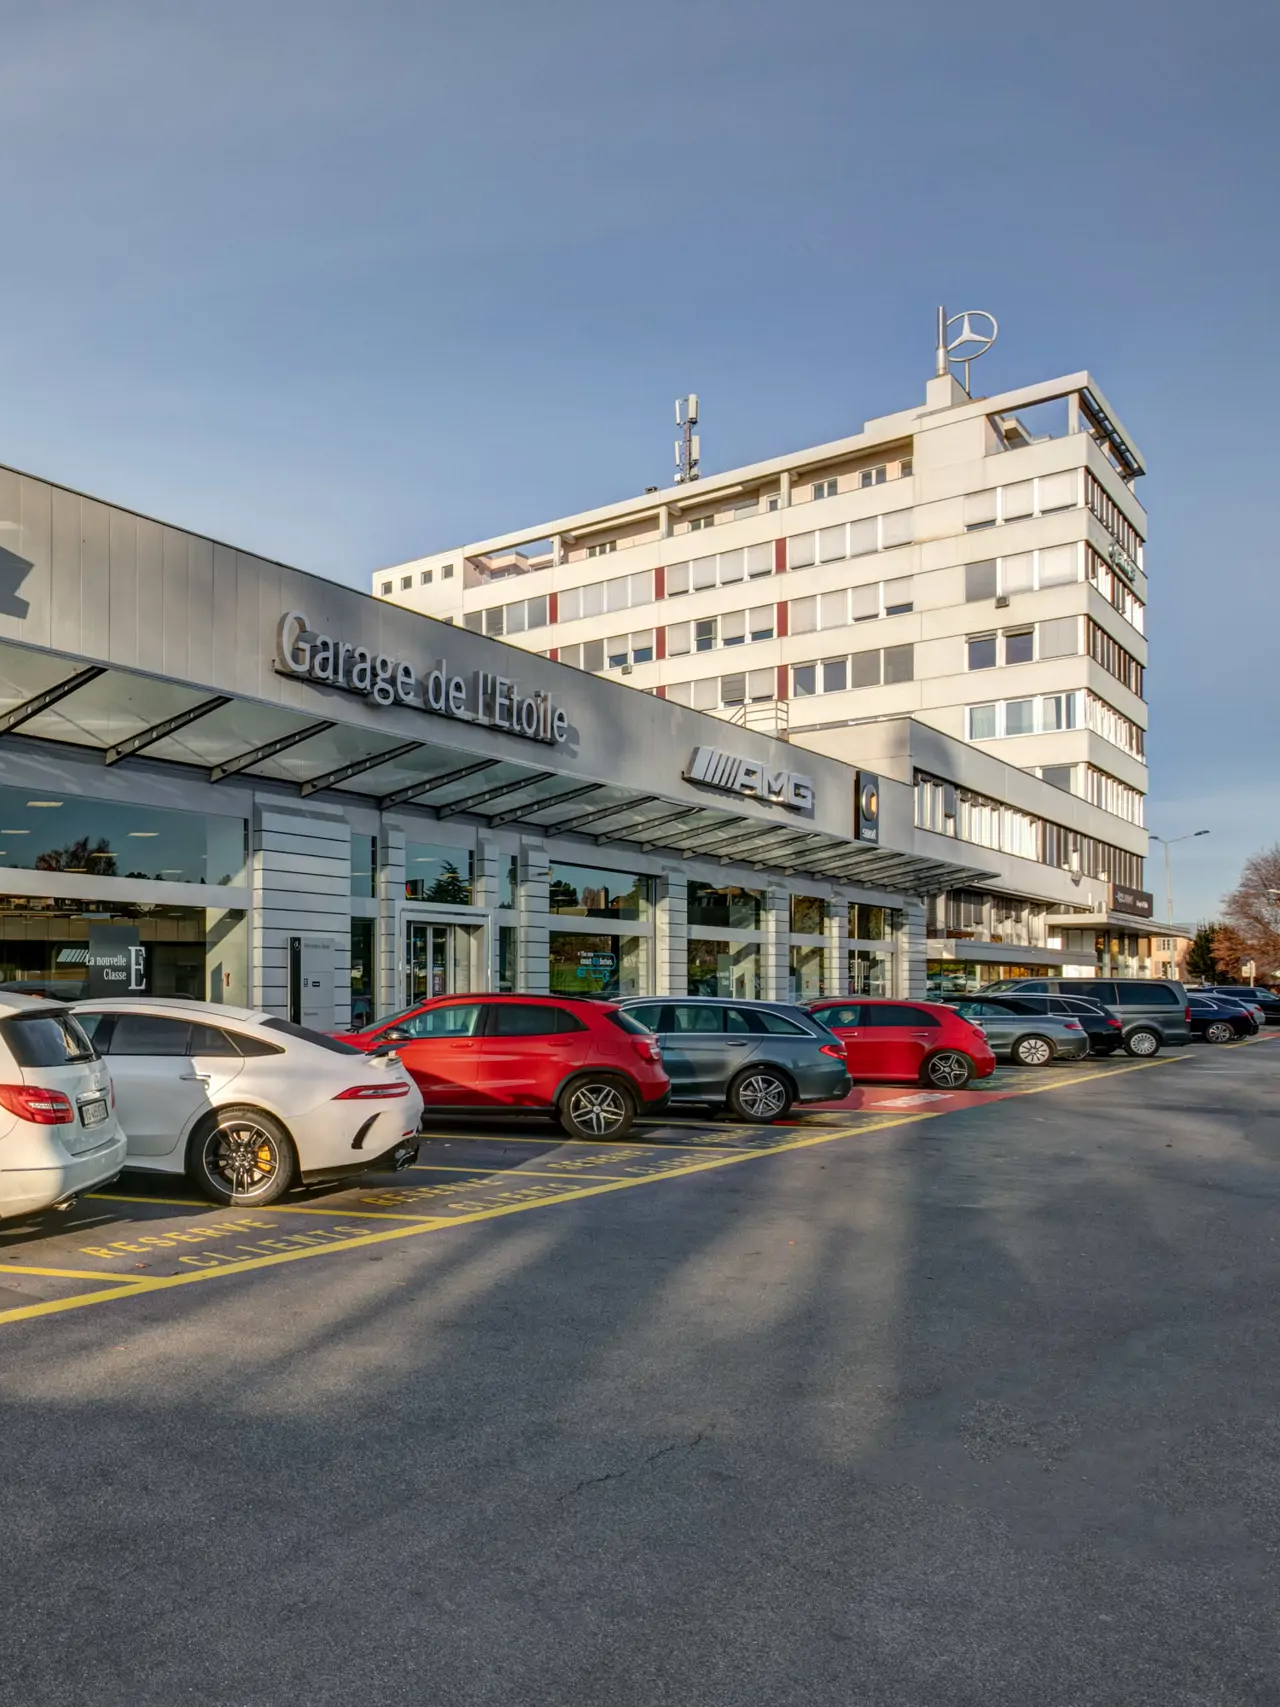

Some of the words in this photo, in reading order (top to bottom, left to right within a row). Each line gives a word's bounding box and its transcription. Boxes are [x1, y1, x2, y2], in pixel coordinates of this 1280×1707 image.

[278, 611, 416, 705] Garage
[426, 659, 467, 715] de
[473, 670, 569, 743] l'Etoile
[732, 758, 814, 809] AMG
[96, 955, 127, 966] nouvelle
[103, 968, 127, 980] Classe
[128, 946, 146, 990] E
[78, 1218, 279, 1259] RESERVE
[177, 1225, 375, 1267] CLIENTS
